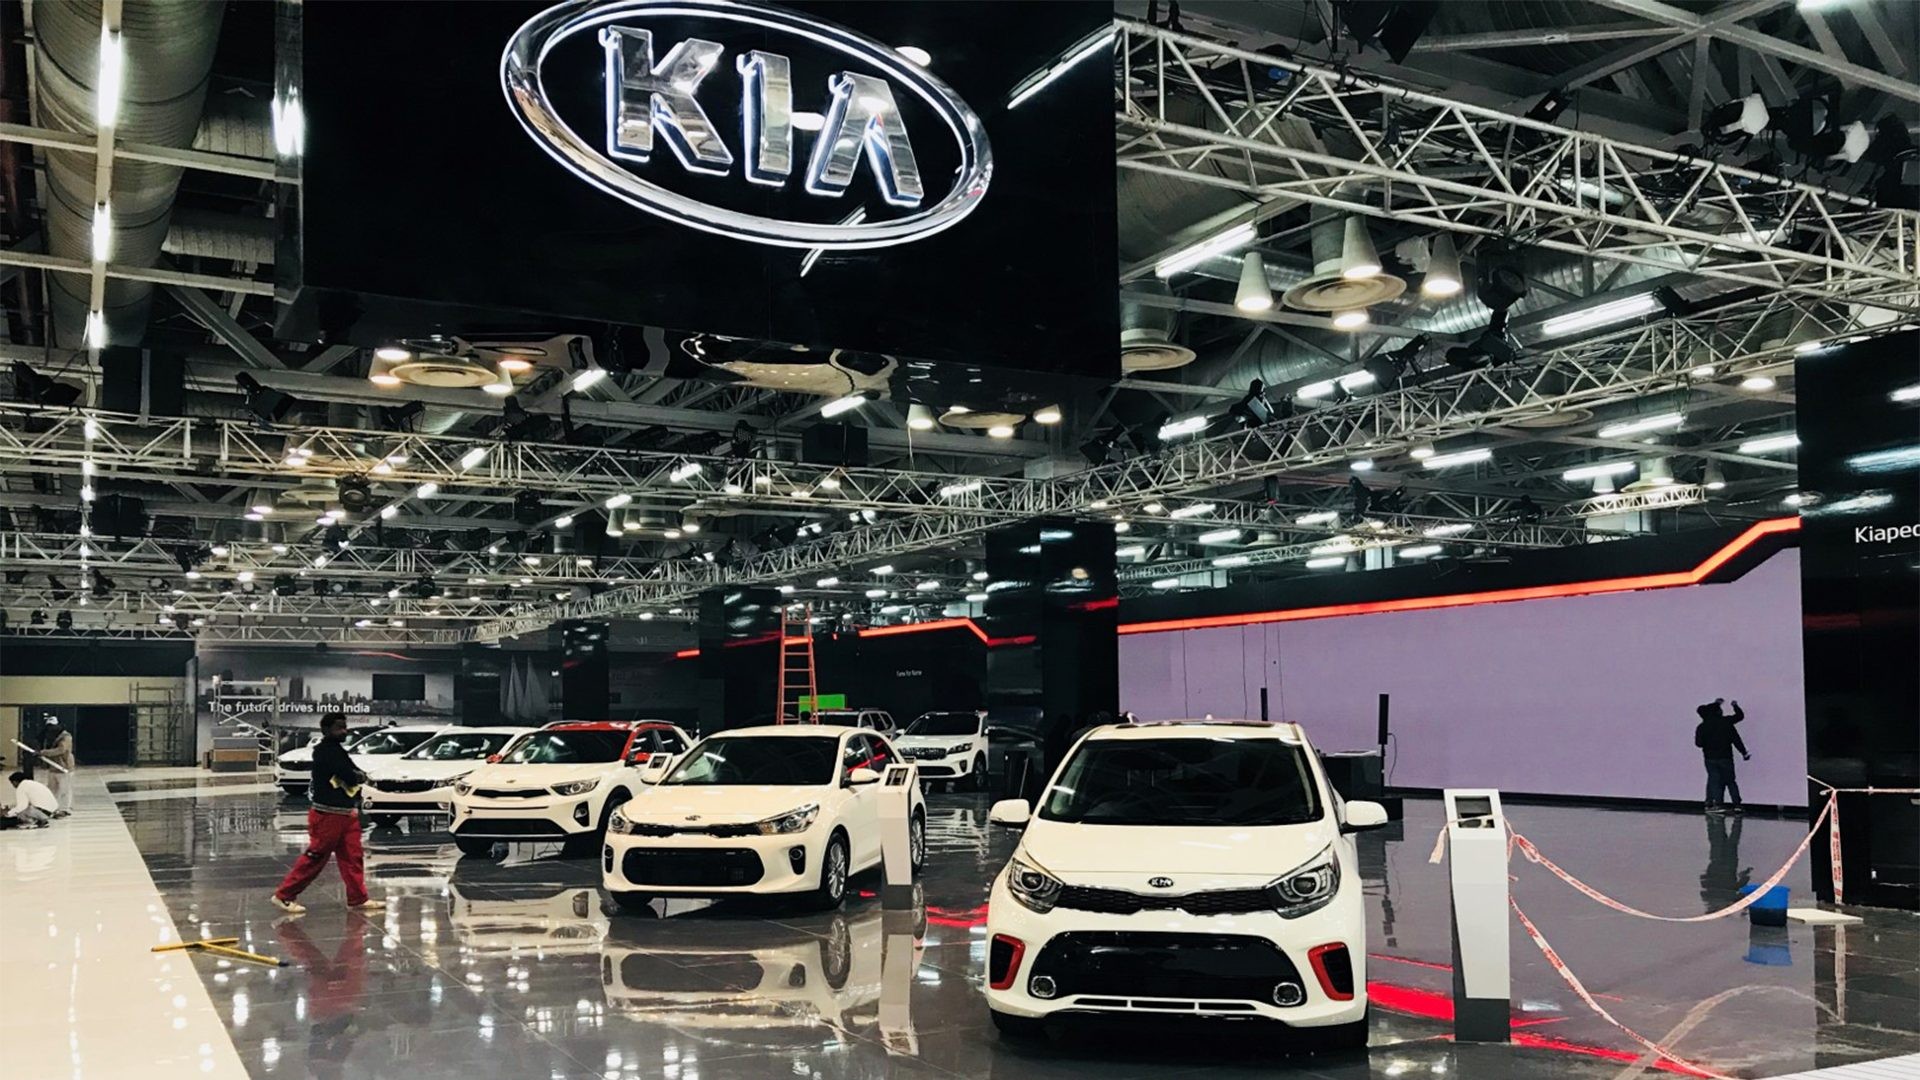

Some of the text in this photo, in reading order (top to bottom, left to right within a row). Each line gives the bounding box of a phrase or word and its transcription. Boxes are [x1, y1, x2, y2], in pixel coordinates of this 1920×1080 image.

[598, 24, 924, 207] KIA
[208, 701, 371, 713] The future drives into India
